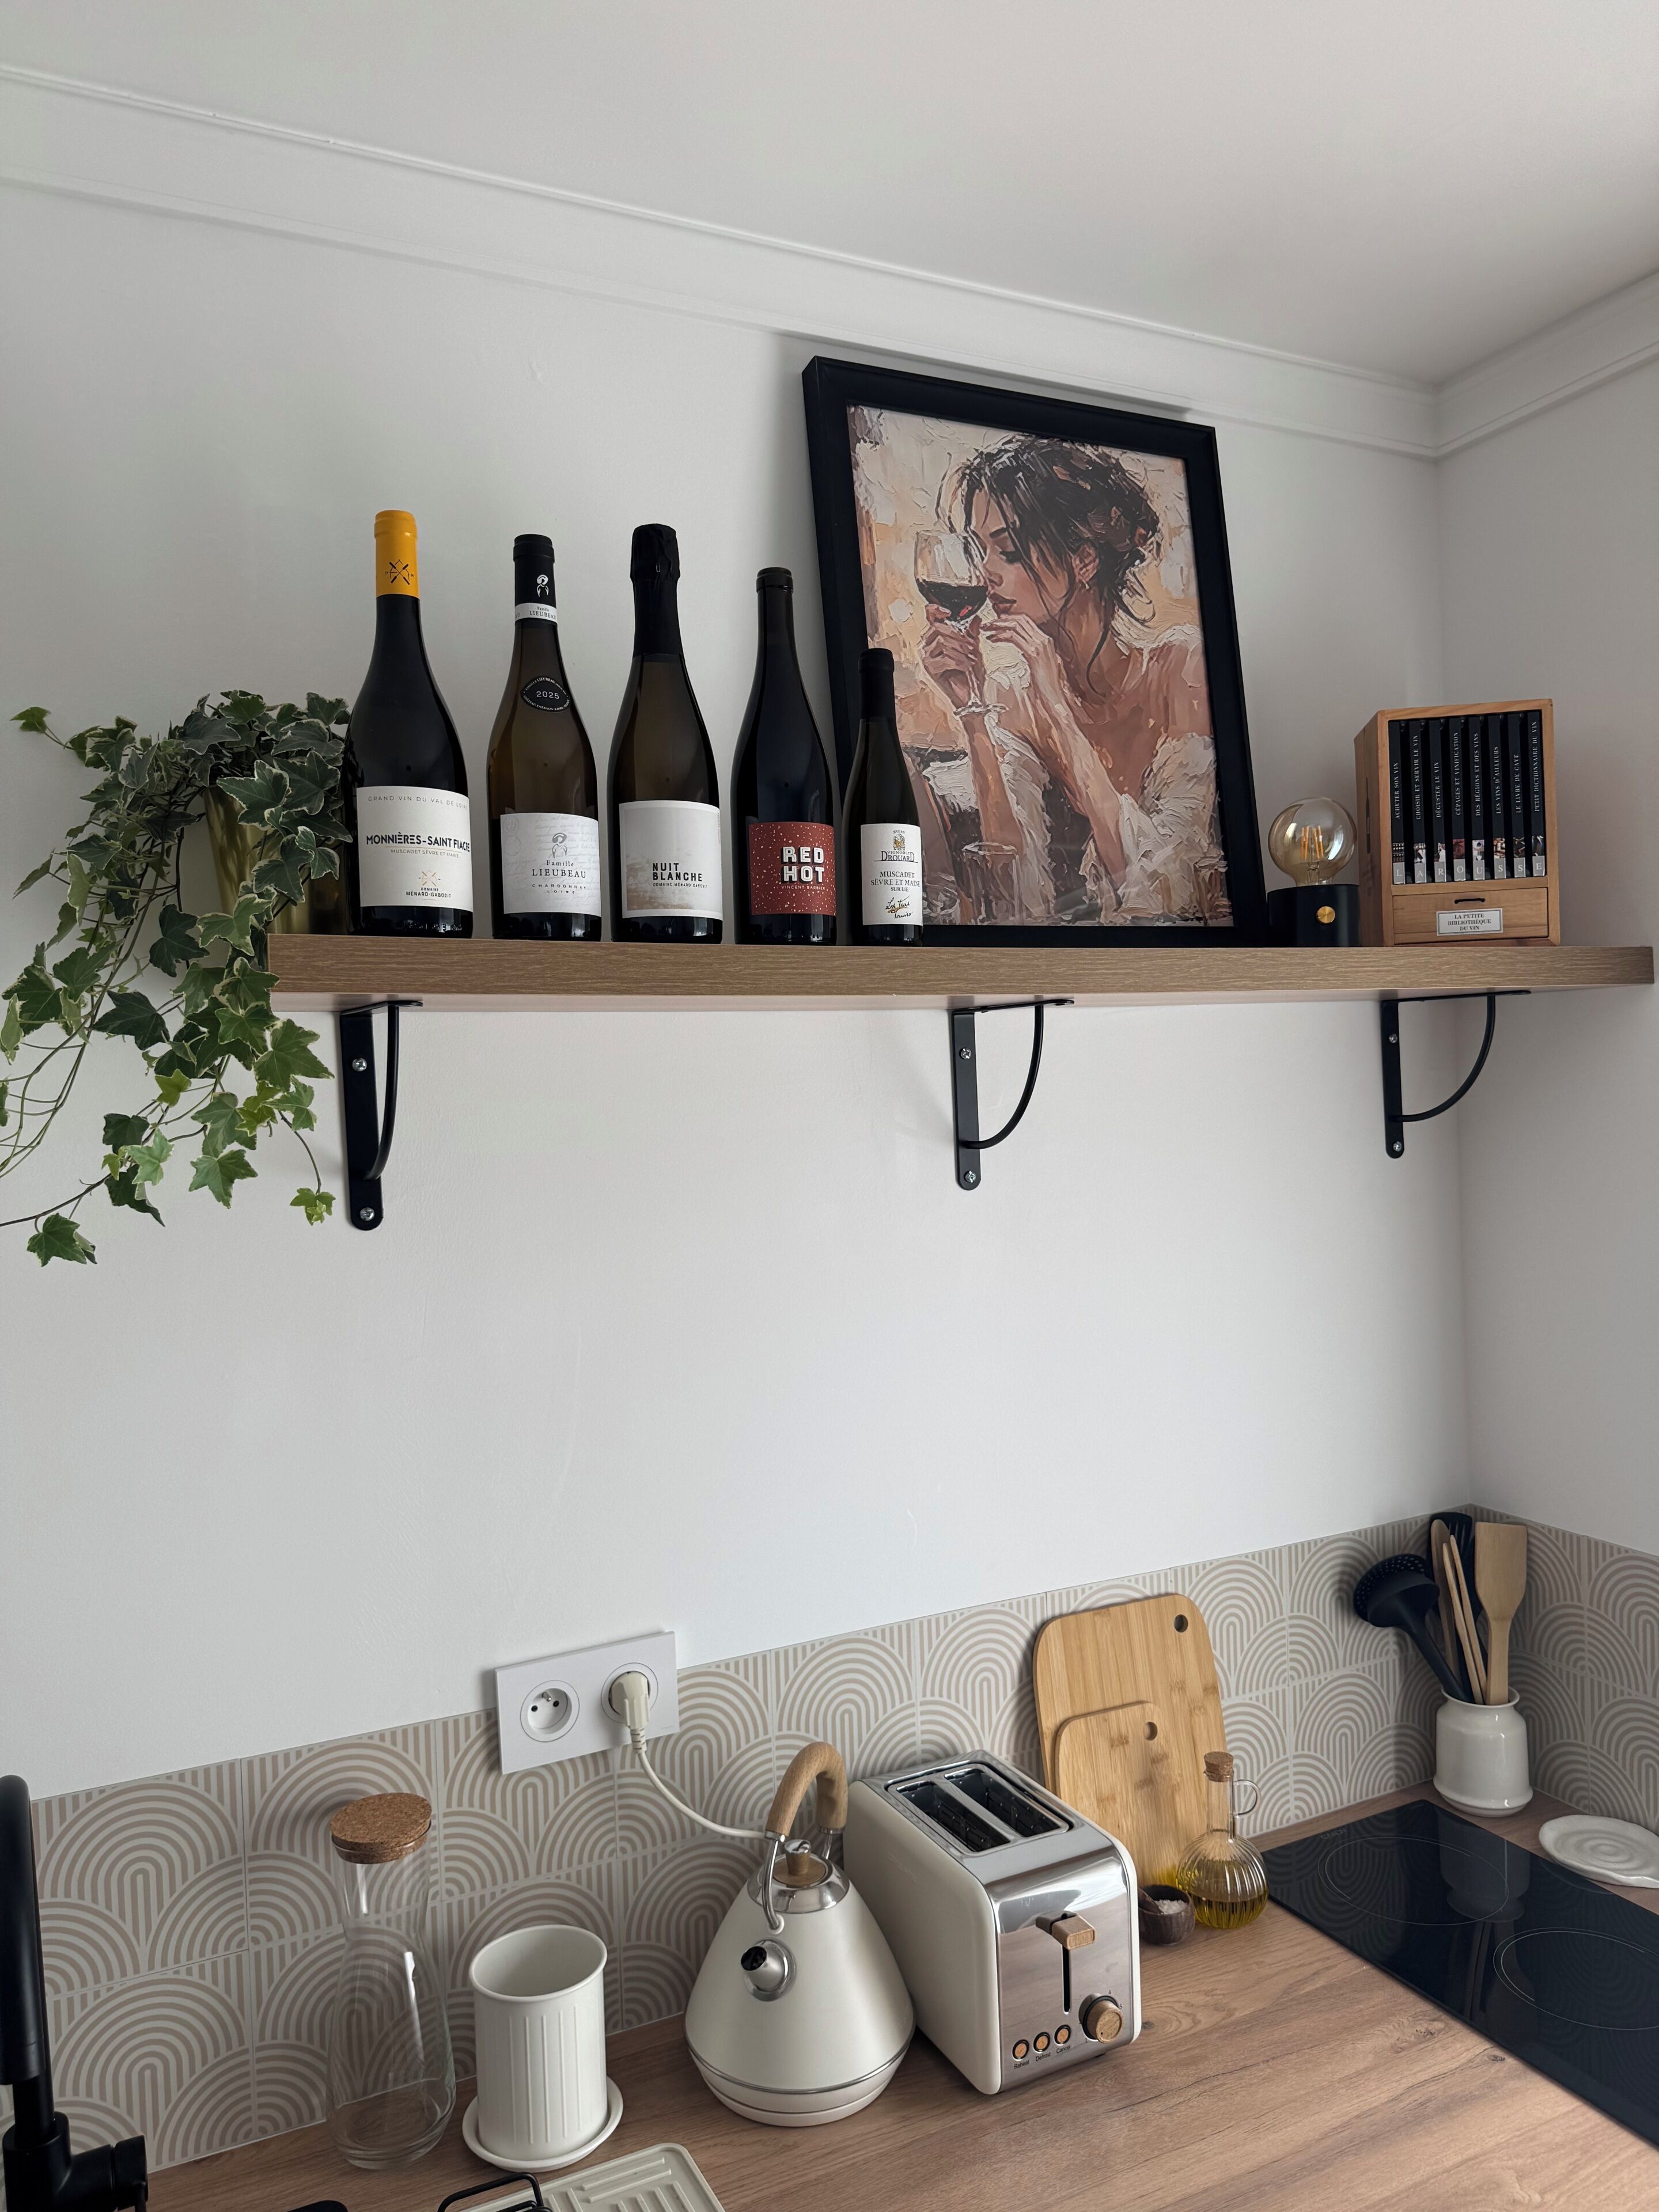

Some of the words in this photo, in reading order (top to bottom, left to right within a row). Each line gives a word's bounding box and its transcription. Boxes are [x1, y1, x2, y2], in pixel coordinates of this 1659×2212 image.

[536, 691, 559, 699] 2025
[1532, 736, 1538, 744] DU
[1413, 749, 1419, 757] LE
[1455, 777, 1461, 785] ET
[1514, 773, 1520, 782] DE
[1414, 783, 1421, 791] ET
[1434, 786, 1442, 818] DÉGUSTER
[1516, 805, 1521, 813] LE
[453, 839, 470, 853] FIACRE
[782, 846, 824, 863] RED
[881, 851, 915, 862] DROUARD
[652, 863, 679, 872] NUIT
[532, 869, 586, 878] LIEUBEAU
[652, 872, 703, 882] BLANCHE
[782, 865, 825, 882] HOT
[870, 878, 893, 886] SÈVRE
[1056, 2044, 1071, 2054] Cancel
[1036, 2052, 1051, 2061] Defrost
[1014, 2060, 1029, 2069] Reheat
